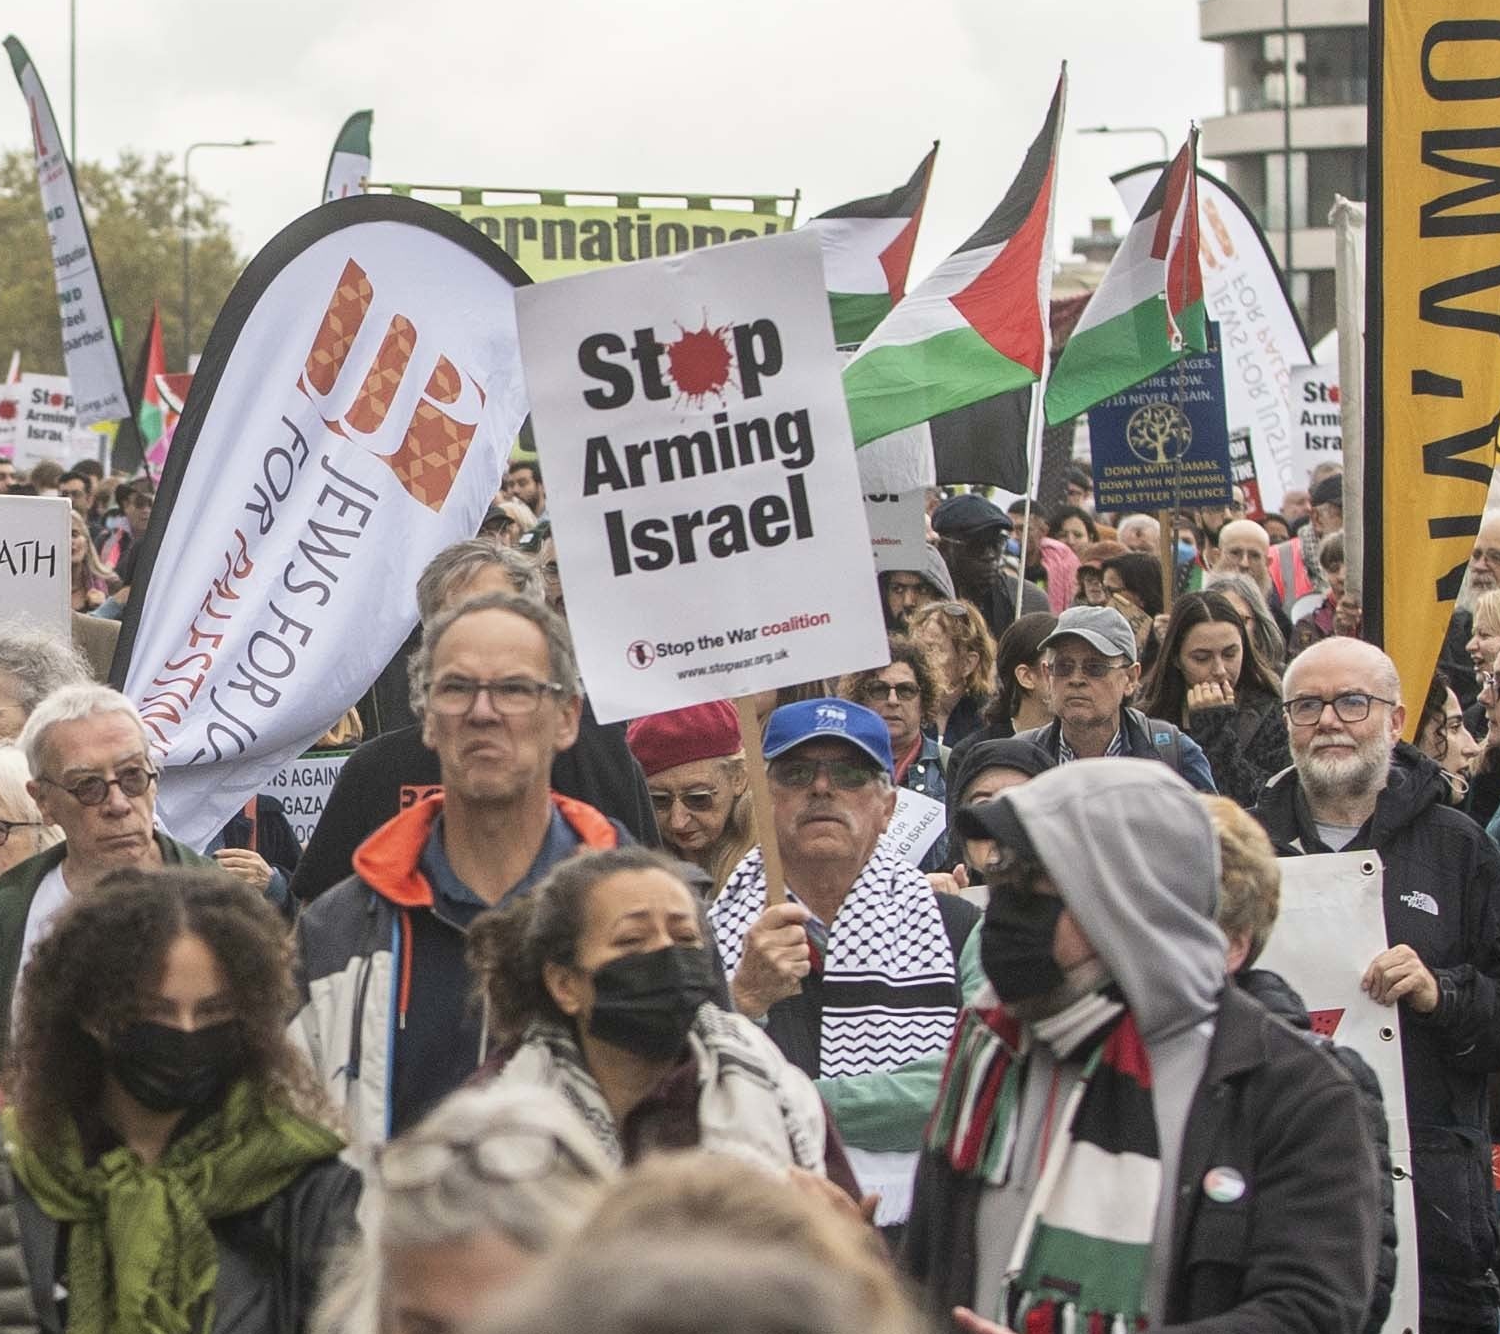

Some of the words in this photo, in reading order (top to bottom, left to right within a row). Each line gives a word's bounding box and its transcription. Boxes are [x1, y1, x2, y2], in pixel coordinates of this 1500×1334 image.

[577, 316, 786, 411] Stop
[244, 413, 309, 537] FOR
[582, 407, 816, 498] Arming
[1305, 431, 1343, 451] Isra
[283, 454, 381, 608] JEWS
[603, 473, 815, 577] Israel
[227, 600, 314, 711] FOR
[655, 639, 697, 660] Stop
[698, 631, 725, 651] the
[727, 625, 760, 647] War
[760, 610, 831, 639] coalition
